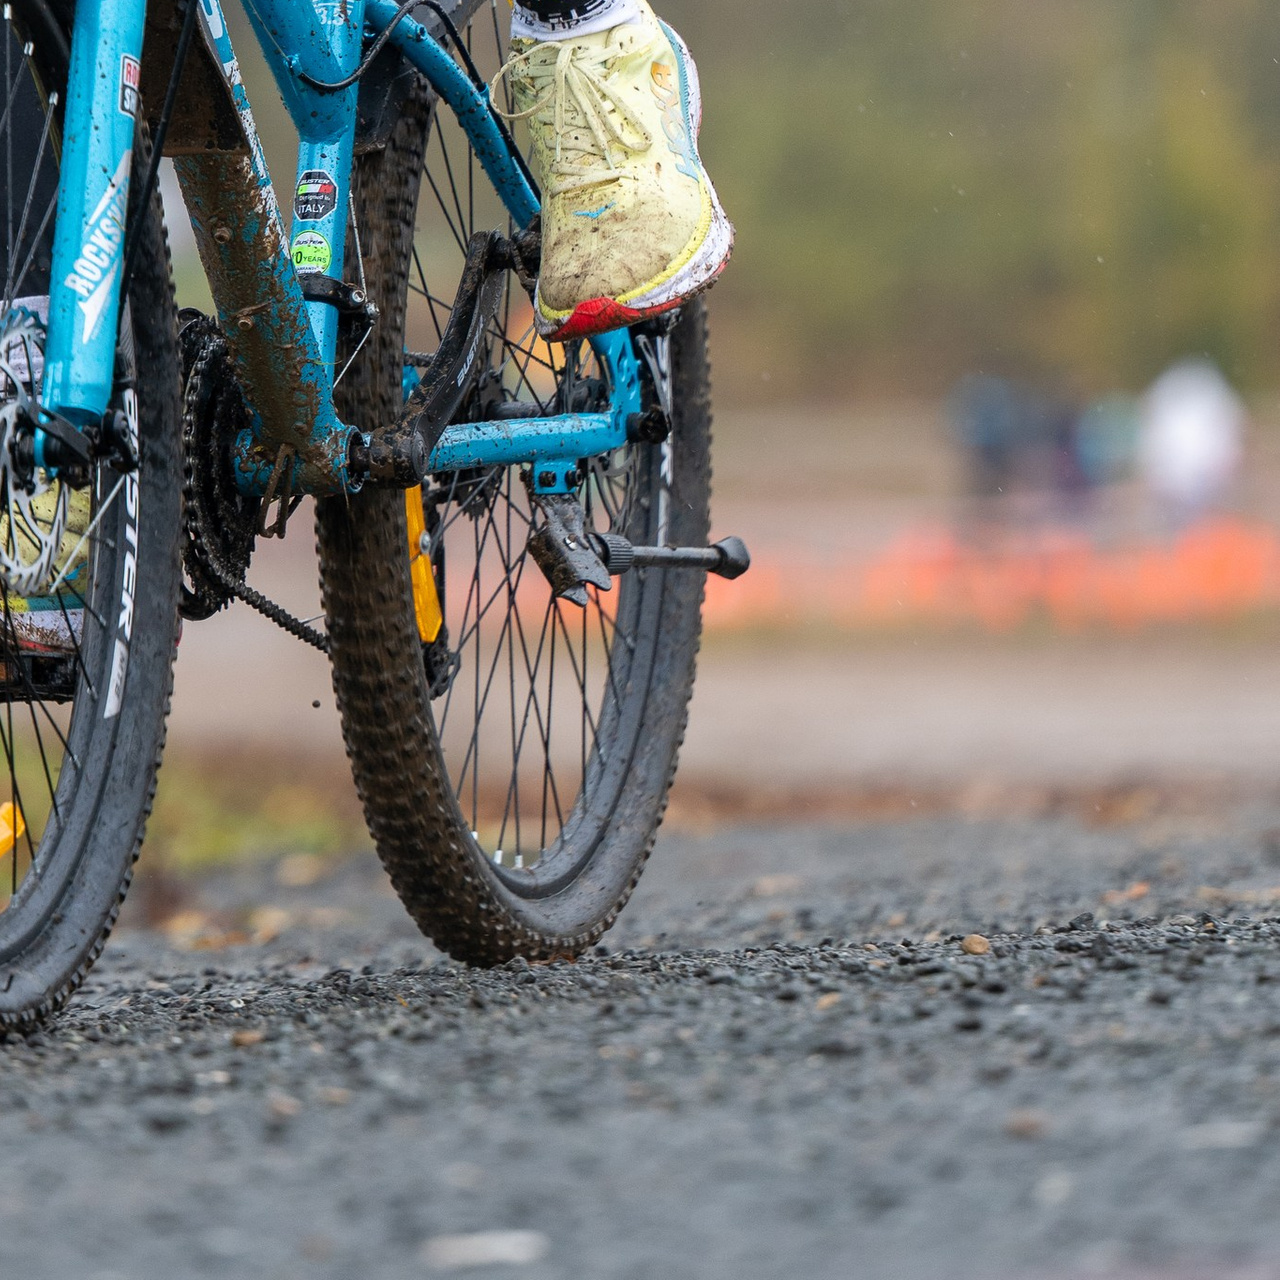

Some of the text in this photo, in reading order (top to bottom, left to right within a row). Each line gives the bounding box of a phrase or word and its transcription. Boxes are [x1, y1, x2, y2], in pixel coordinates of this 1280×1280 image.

[298, 203, 326, 214] ITALY
[303, 255, 328, 264] YEARS
[118, 388, 139, 641] BSTER
